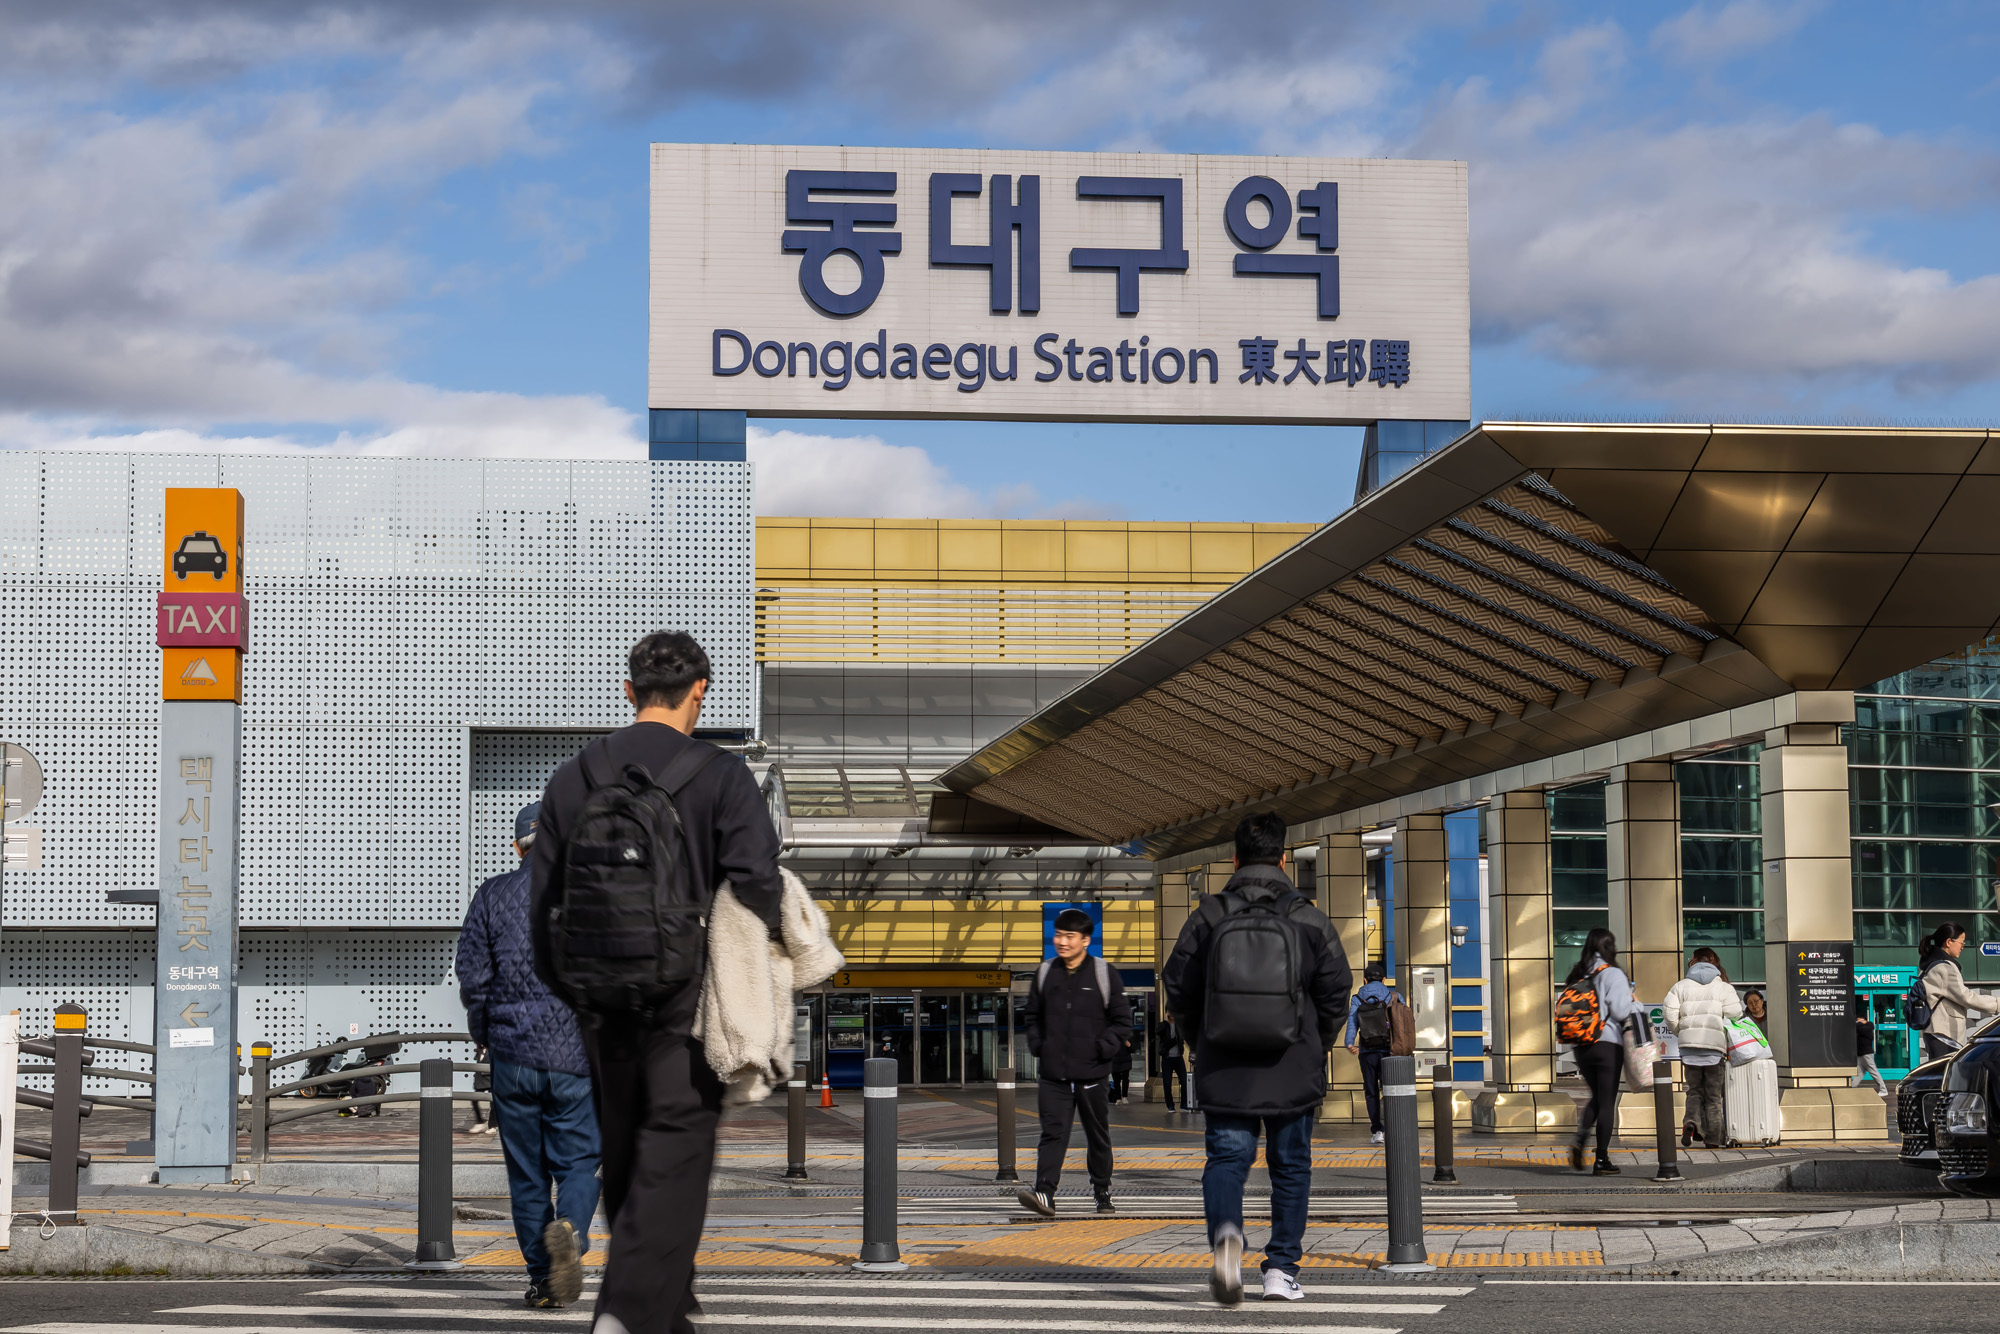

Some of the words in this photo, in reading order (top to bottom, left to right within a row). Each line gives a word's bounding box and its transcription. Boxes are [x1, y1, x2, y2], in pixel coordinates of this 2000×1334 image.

[782, 169, 1340, 319] 동대구역
[711, 328, 1020, 392] Dongdaegu
[1033, 332, 1219, 384] Station
[1238, 335, 1411, 388] 東大邱驛
[162, 604, 236, 634] TAXI
[166, 983, 207, 992] Dongdaegu
[168, 966, 219, 981] 동대구역
[843, 973, 850, 986] 3
